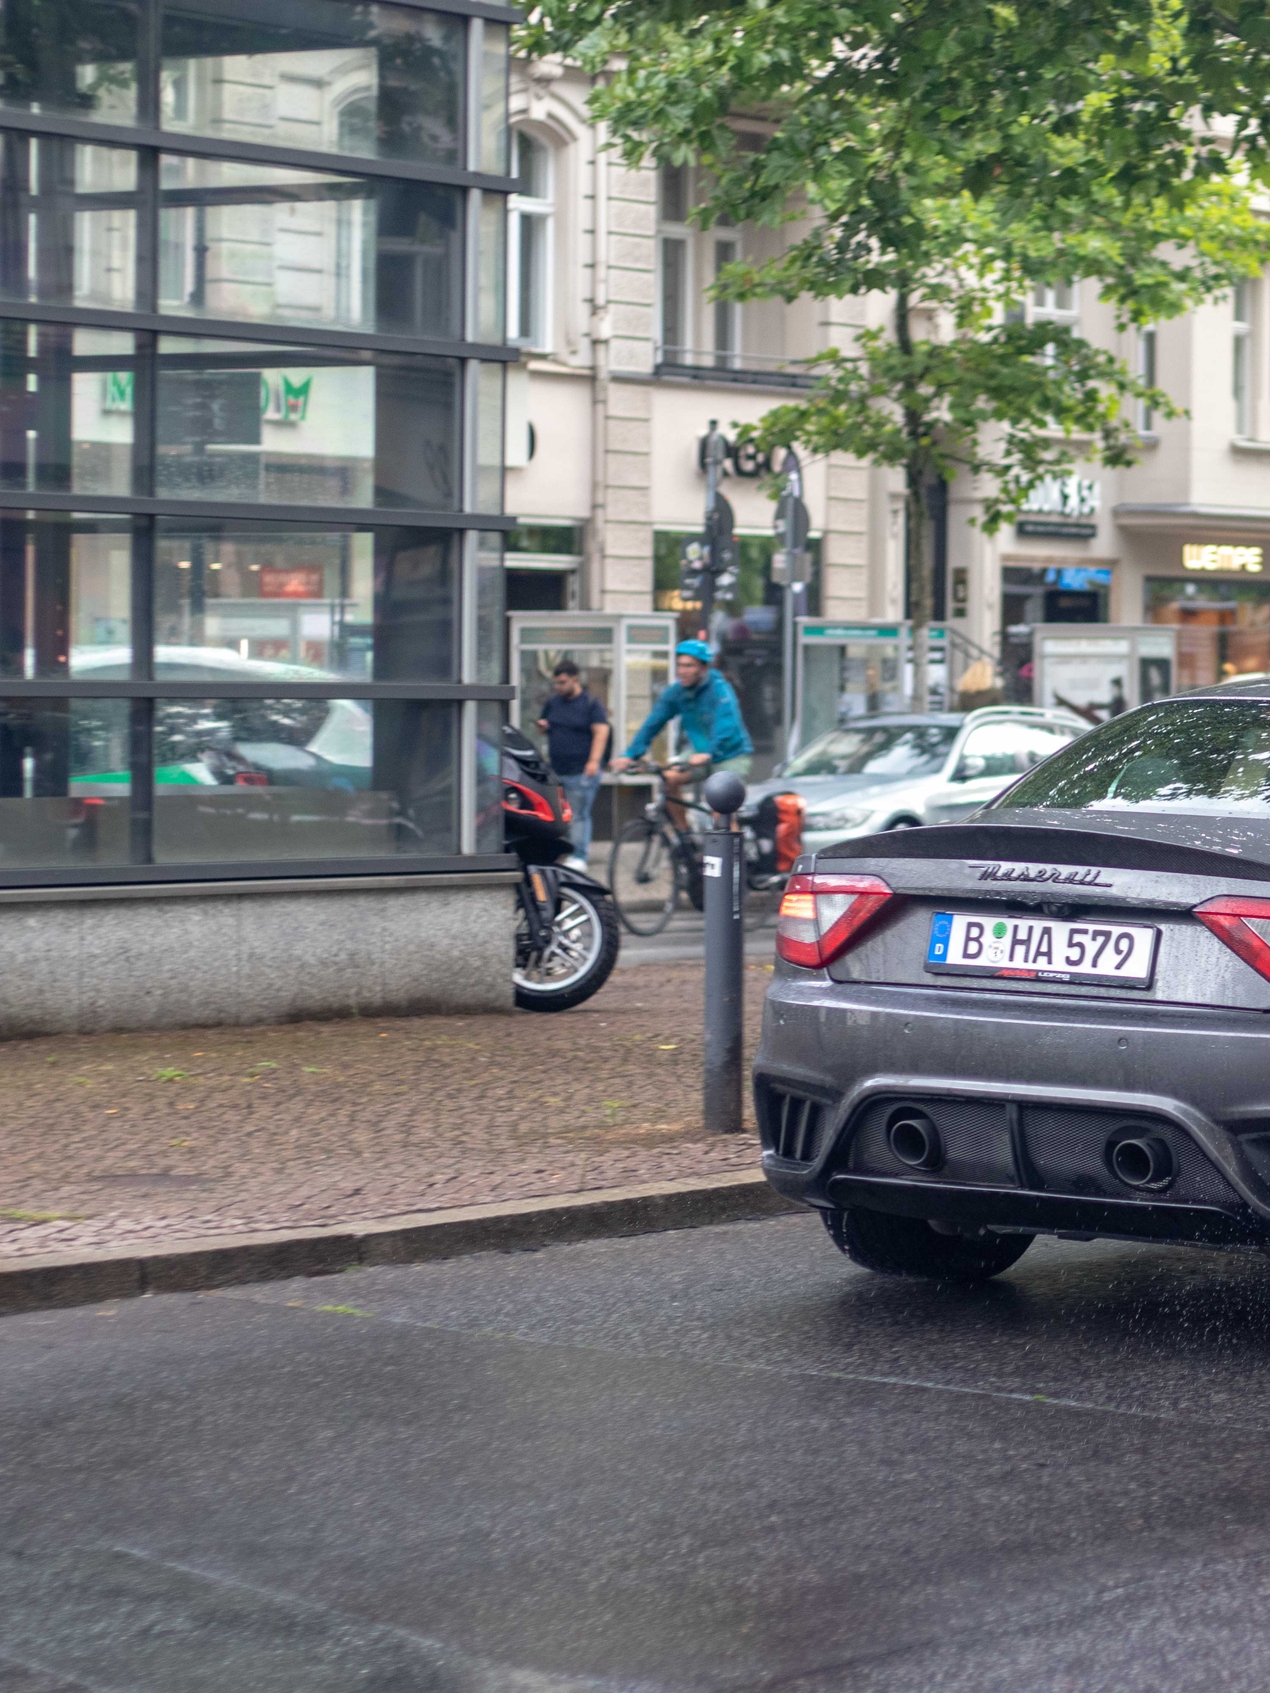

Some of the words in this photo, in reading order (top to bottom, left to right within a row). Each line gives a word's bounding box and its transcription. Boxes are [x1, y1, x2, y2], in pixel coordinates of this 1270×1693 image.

[1182, 543, 1263, 574] WEMPE
[968, 863, 1113, 888] Maserati
[934, 943, 944, 955] D
[962, 921, 985, 959] B
[1008, 924, 1053, 964] HA
[1064, 928, 1135, 970] 579
